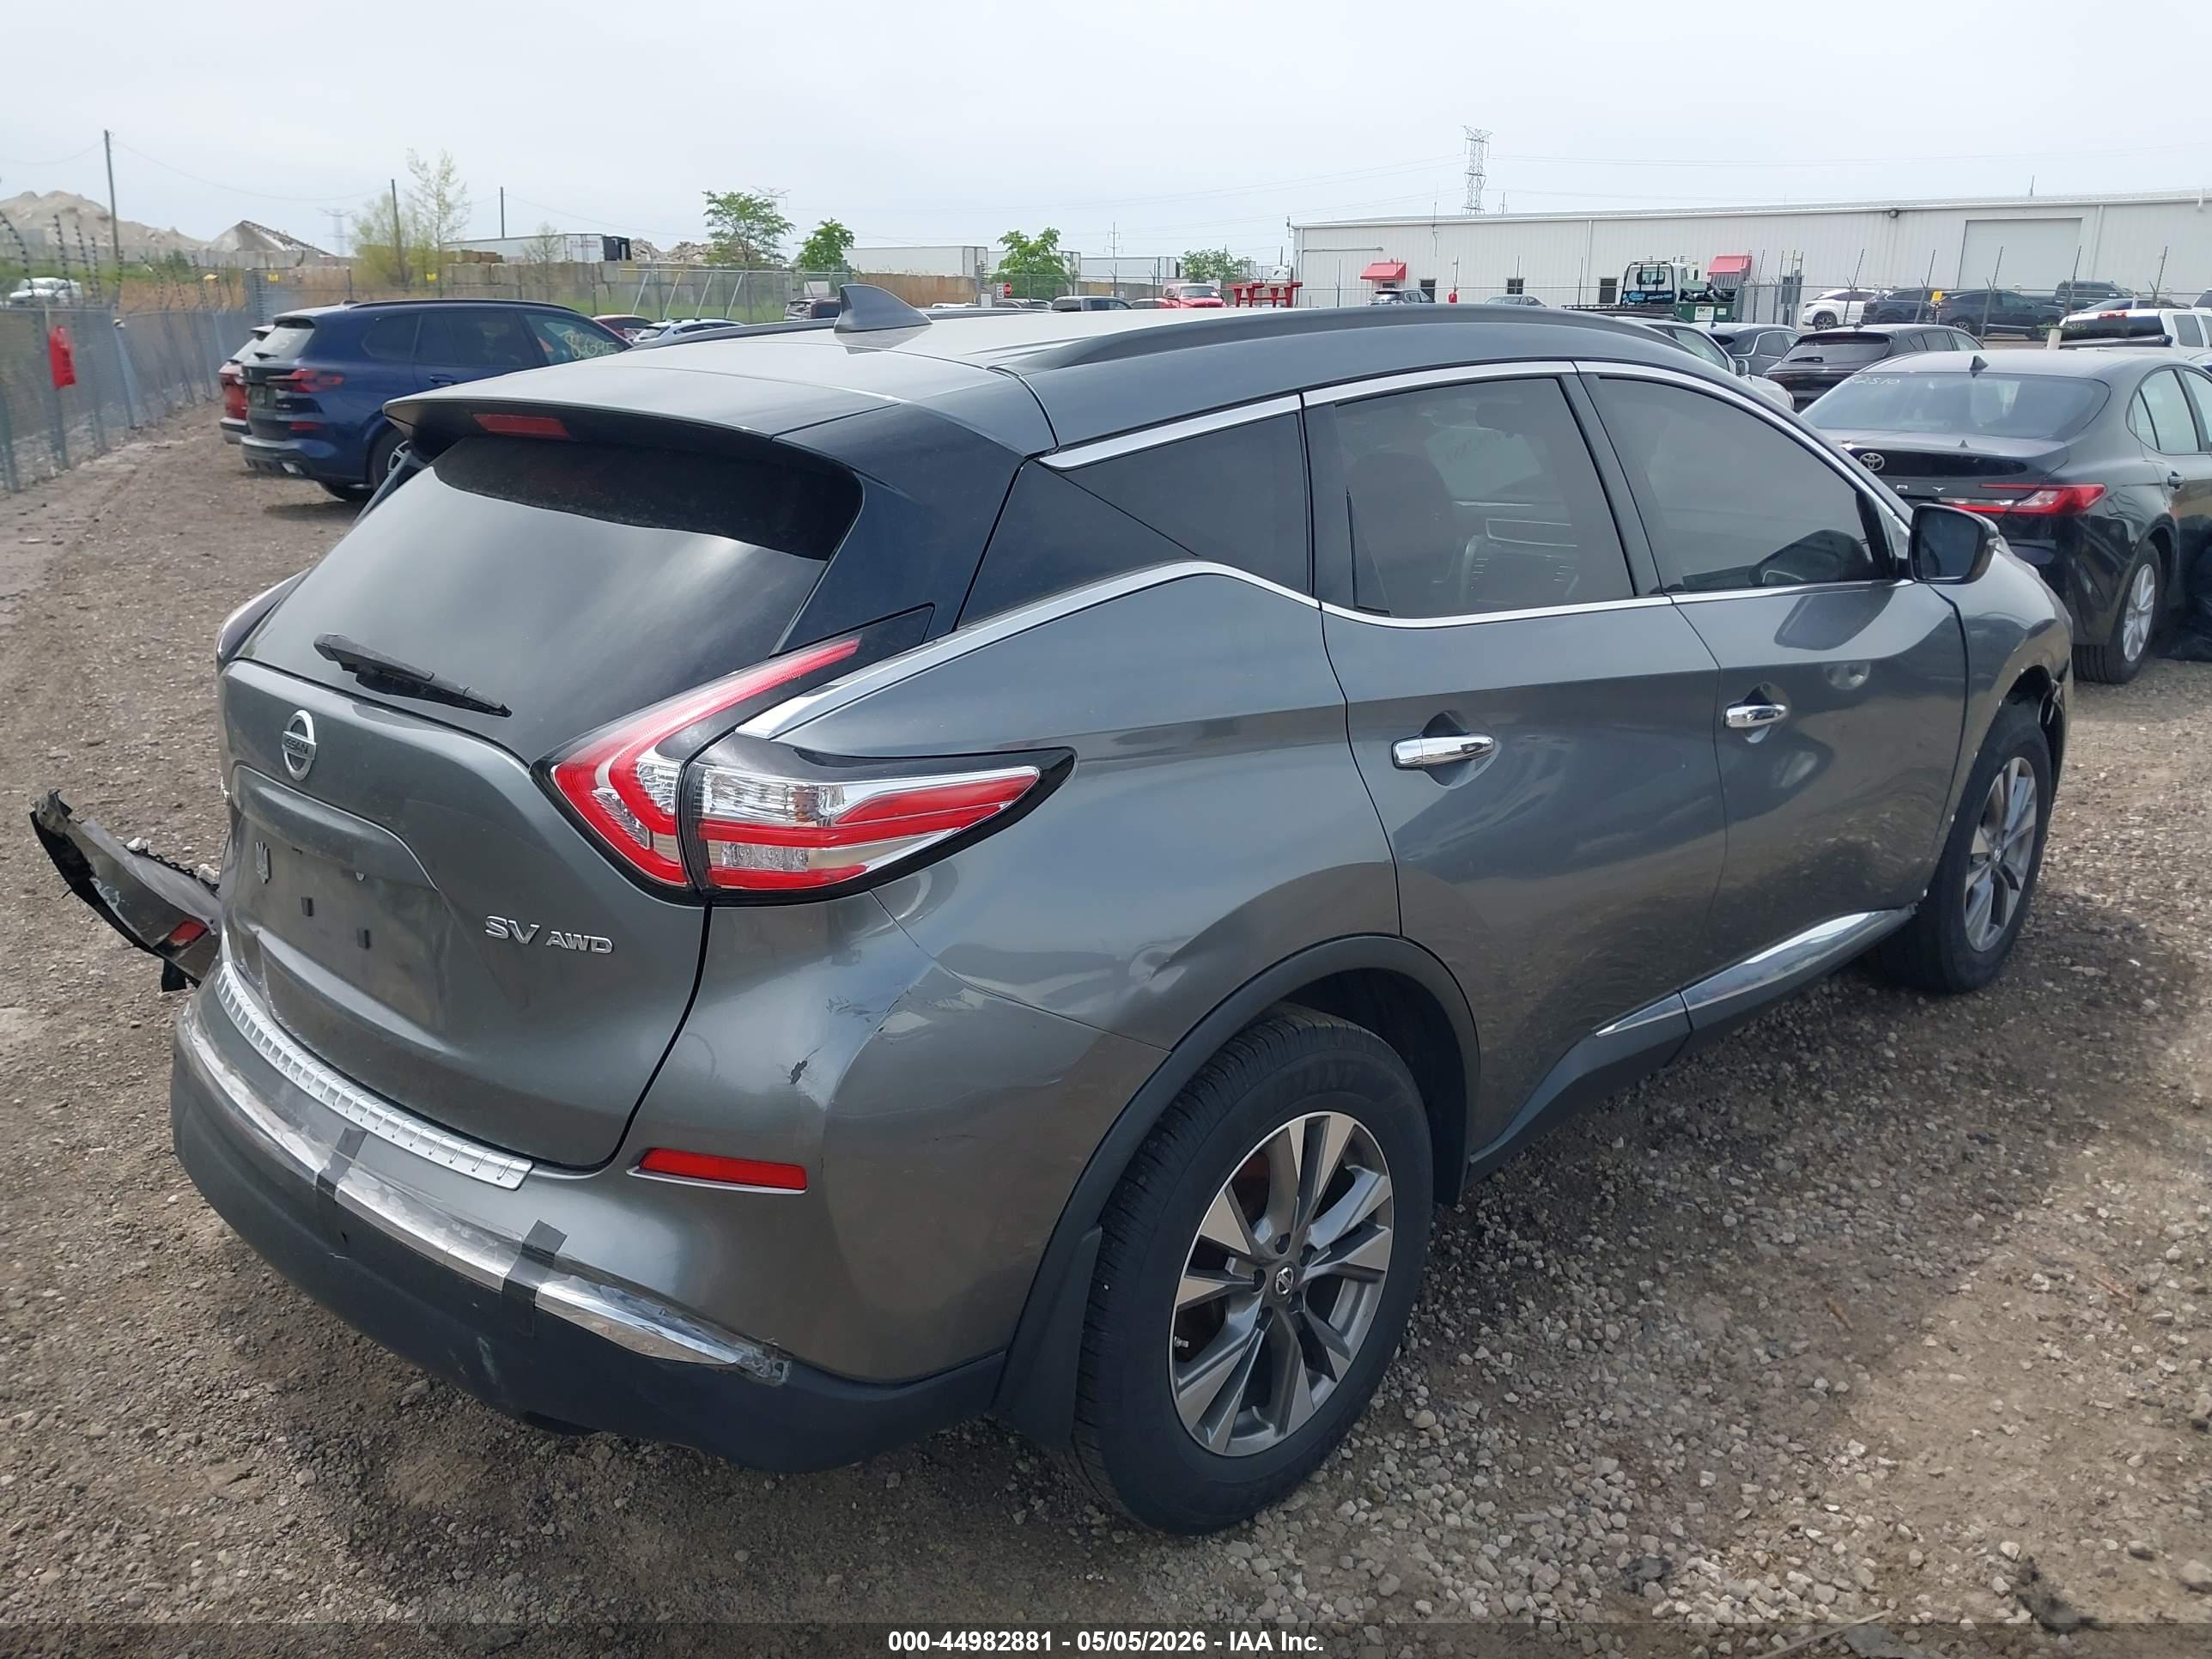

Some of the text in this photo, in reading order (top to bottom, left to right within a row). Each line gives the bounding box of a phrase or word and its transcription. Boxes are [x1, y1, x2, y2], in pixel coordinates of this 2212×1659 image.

[283, 736, 309, 755] SSAN
[485, 915, 613, 954] SV AWD
